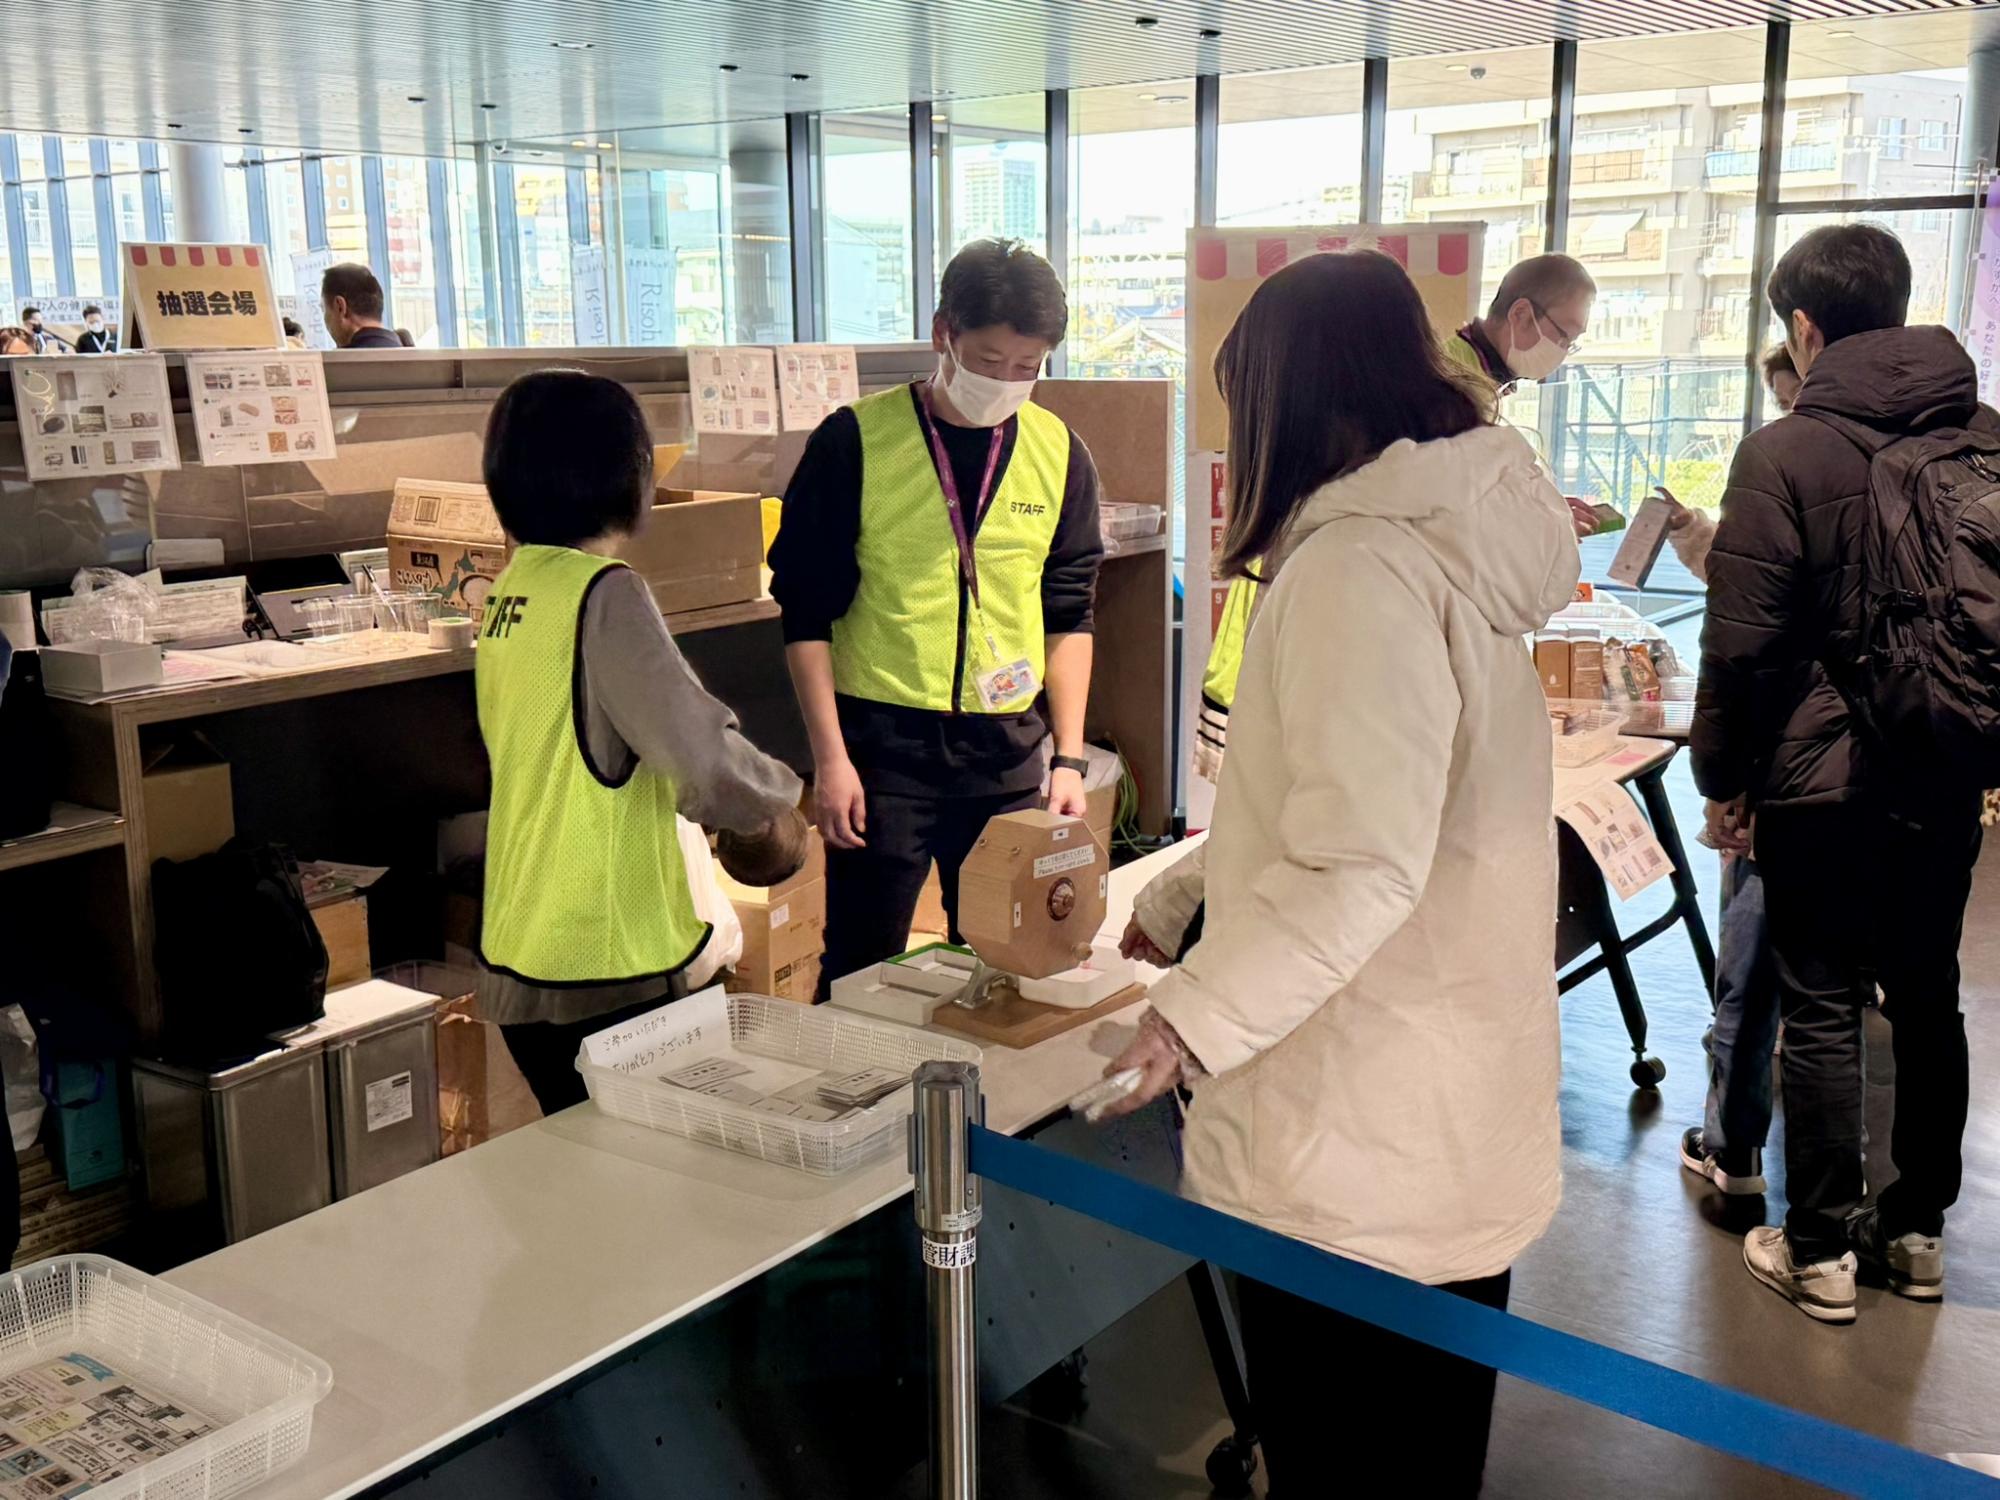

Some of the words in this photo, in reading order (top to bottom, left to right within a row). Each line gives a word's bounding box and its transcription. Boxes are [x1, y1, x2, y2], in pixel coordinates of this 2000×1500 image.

[157, 290, 258, 317] 抽選会場
[641, 283, 662, 342] Risoh
[1010, 501, 1046, 517] STAFF
[923, 1241, 975, 1267] 管財課
